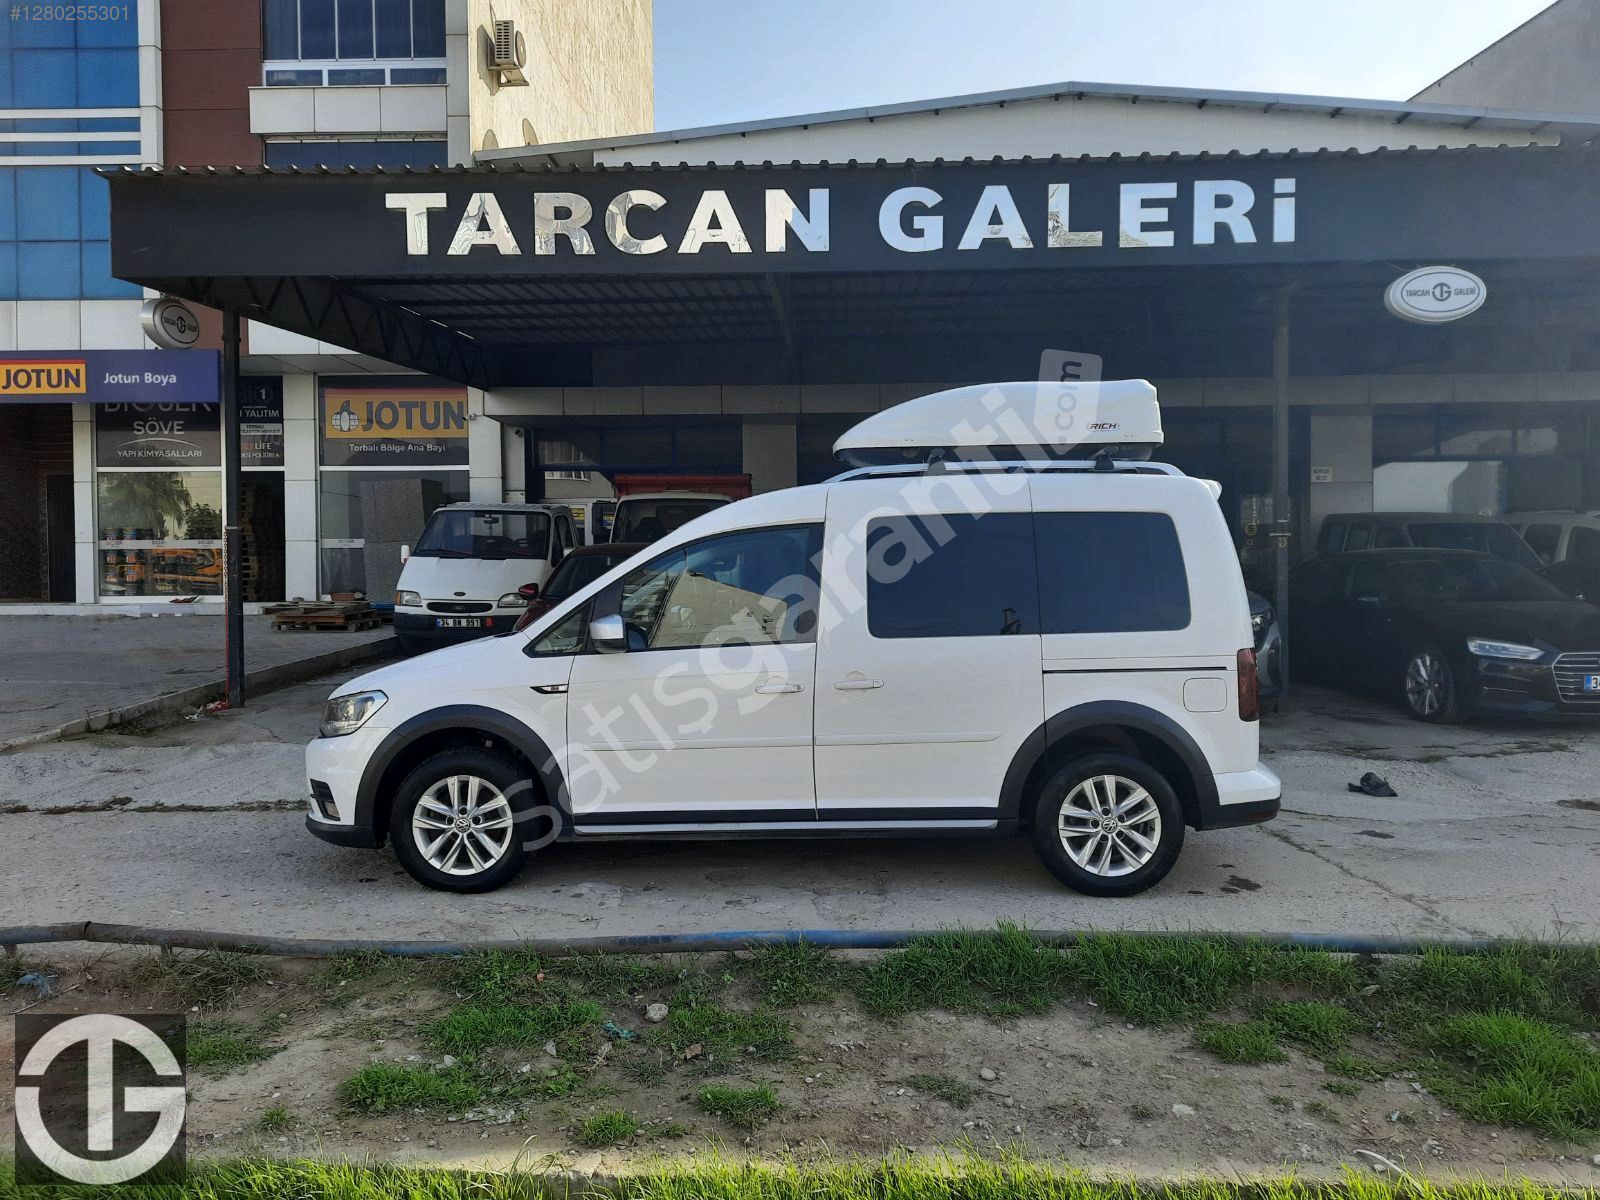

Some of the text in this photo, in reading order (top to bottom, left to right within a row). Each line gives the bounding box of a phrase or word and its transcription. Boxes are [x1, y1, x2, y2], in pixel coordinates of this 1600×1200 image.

[385, 188, 830, 255] TARCAN
[1405, 289, 1430, 297] TARCAN
[2, 368, 81, 390] JOTUN
[104, 373, 177, 386] Jotun Boya
[361, 400, 465, 432] JOTUN
[133, 416, 185, 435] SÖVE
[117, 450, 137, 458] YAPI
[348, 443, 446, 454] Torbalı Bölge Ana Bayi
